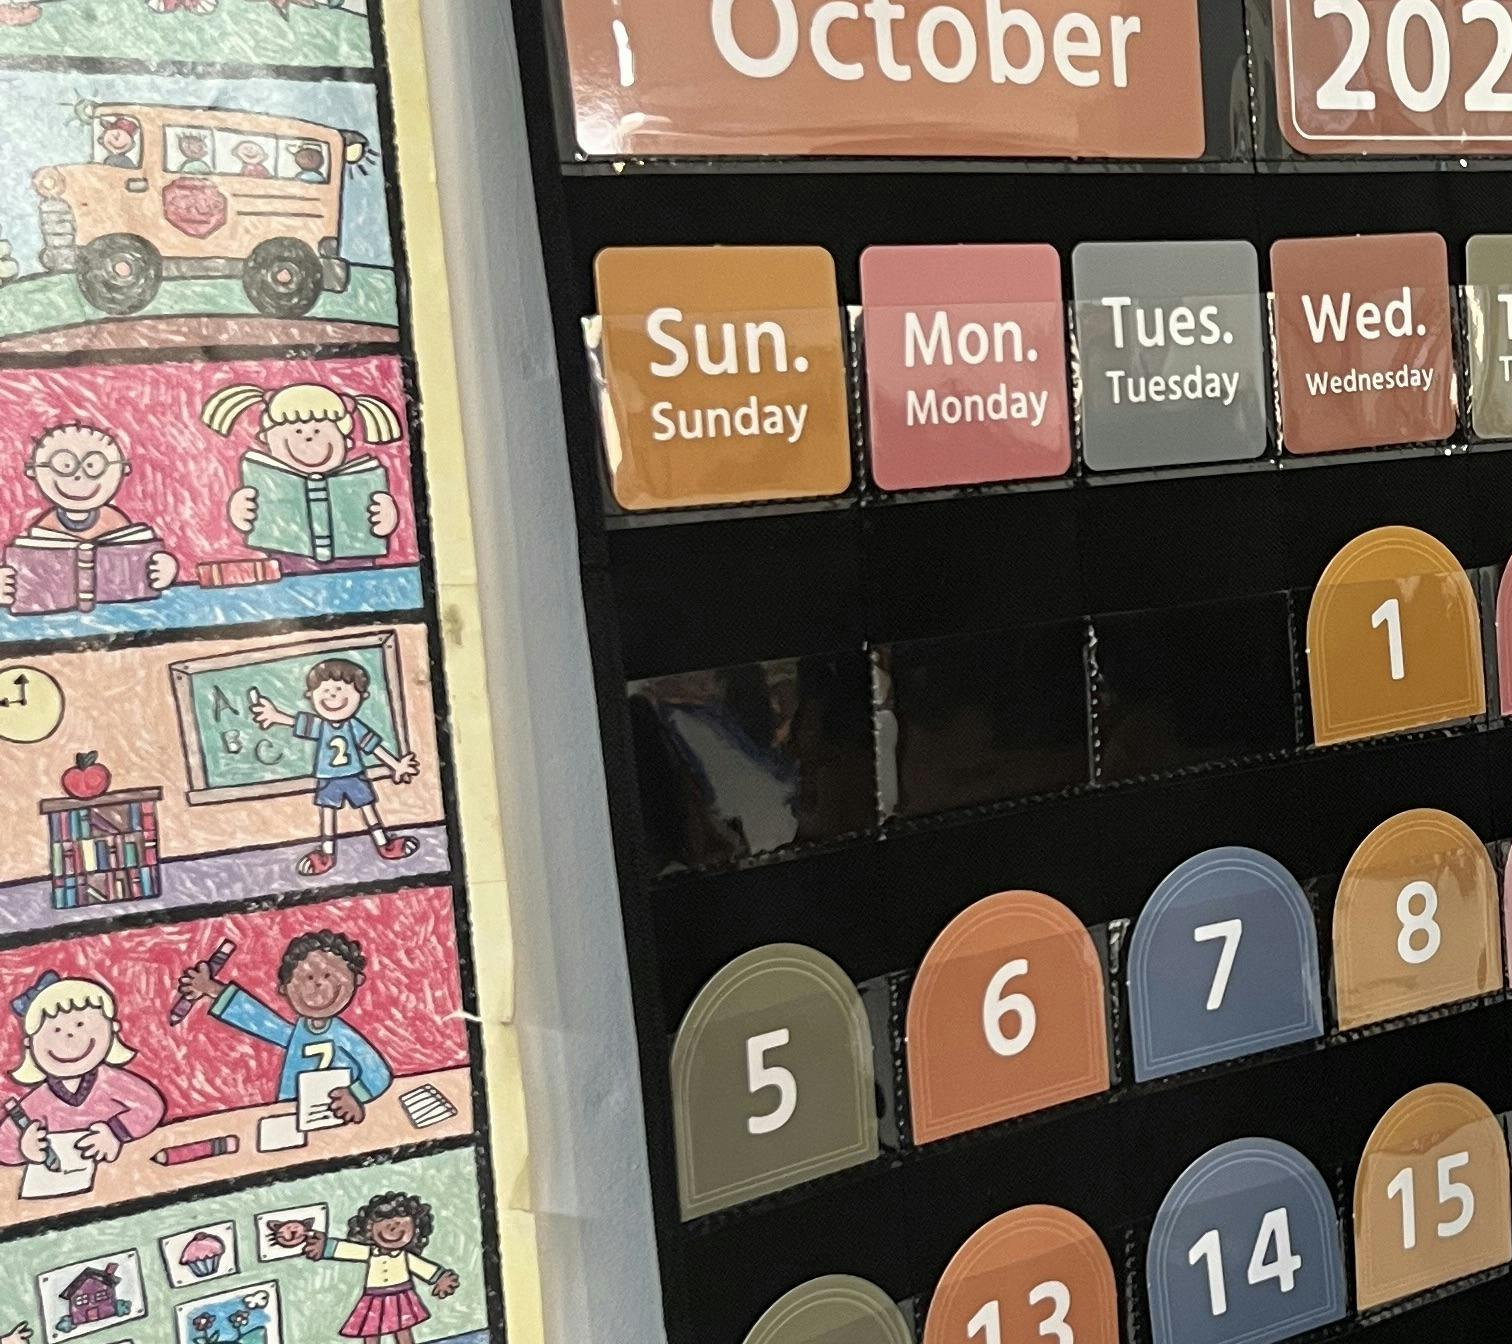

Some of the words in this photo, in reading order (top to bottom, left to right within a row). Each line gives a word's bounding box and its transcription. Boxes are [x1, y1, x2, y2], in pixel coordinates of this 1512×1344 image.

[645, 307, 809, 378] Sun.
[904, 310, 1038, 368] Mon.
[1100, 296, 1234, 348] Tues.
[1301, 286, 1426, 344] Wed.
[905, 383, 1050, 428] Monday
[1105, 364, 1240, 406] Tuesday
[1305, 363, 1434, 396] Wednesday
[651, 394, 809, 445] Sunday
[1371, 598, 1405, 680] 1
[327, 735, 350, 768] 2
[1396, 880, 1441, 964] 8
[1194, 918, 1243, 1011] 7
[982, 958, 1036, 1056] 6
[747, 1028, 797, 1134] 5
[1387, 1151, 1475, 1250] 15
[1188, 1207, 1302, 1316] 14
